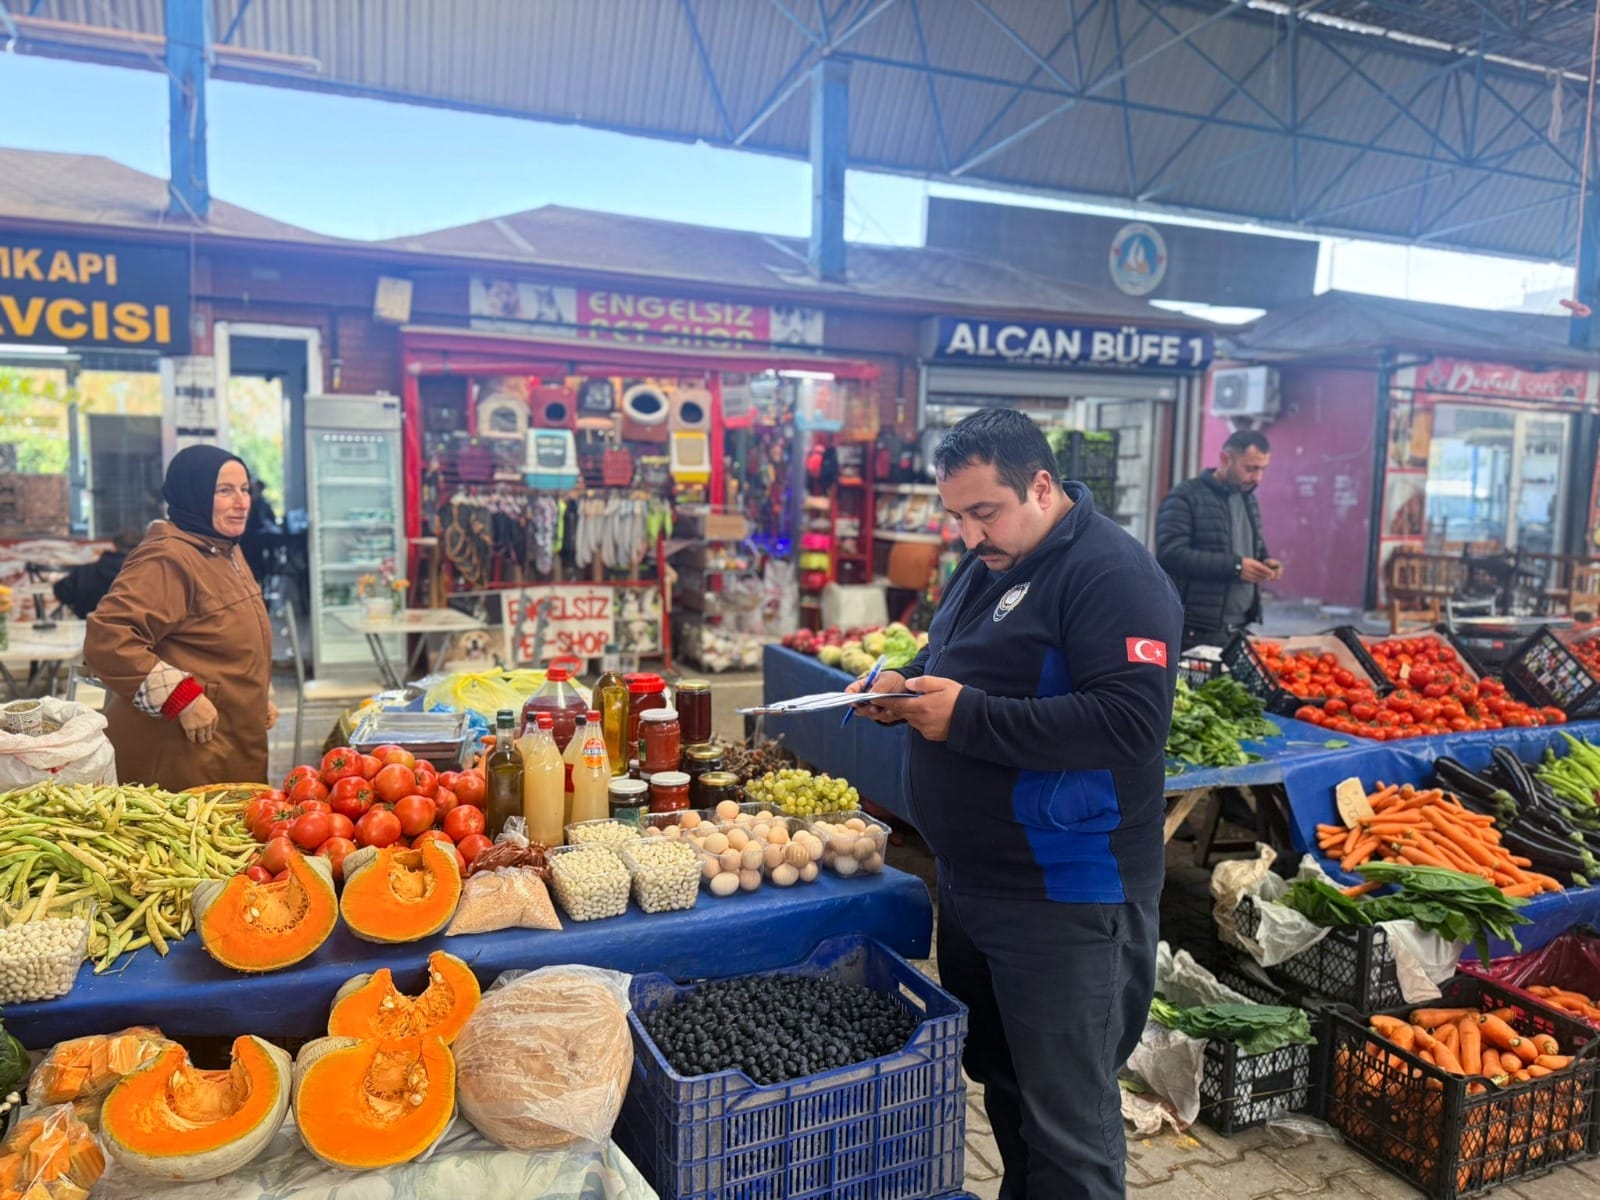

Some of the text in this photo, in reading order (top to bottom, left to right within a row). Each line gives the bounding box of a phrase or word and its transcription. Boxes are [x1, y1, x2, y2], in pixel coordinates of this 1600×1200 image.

[0, 295, 172, 344] VCISI
[946, 323, 1203, 366] ALCAN BÜFE 1
[507, 590, 609, 626] EELSİZ
